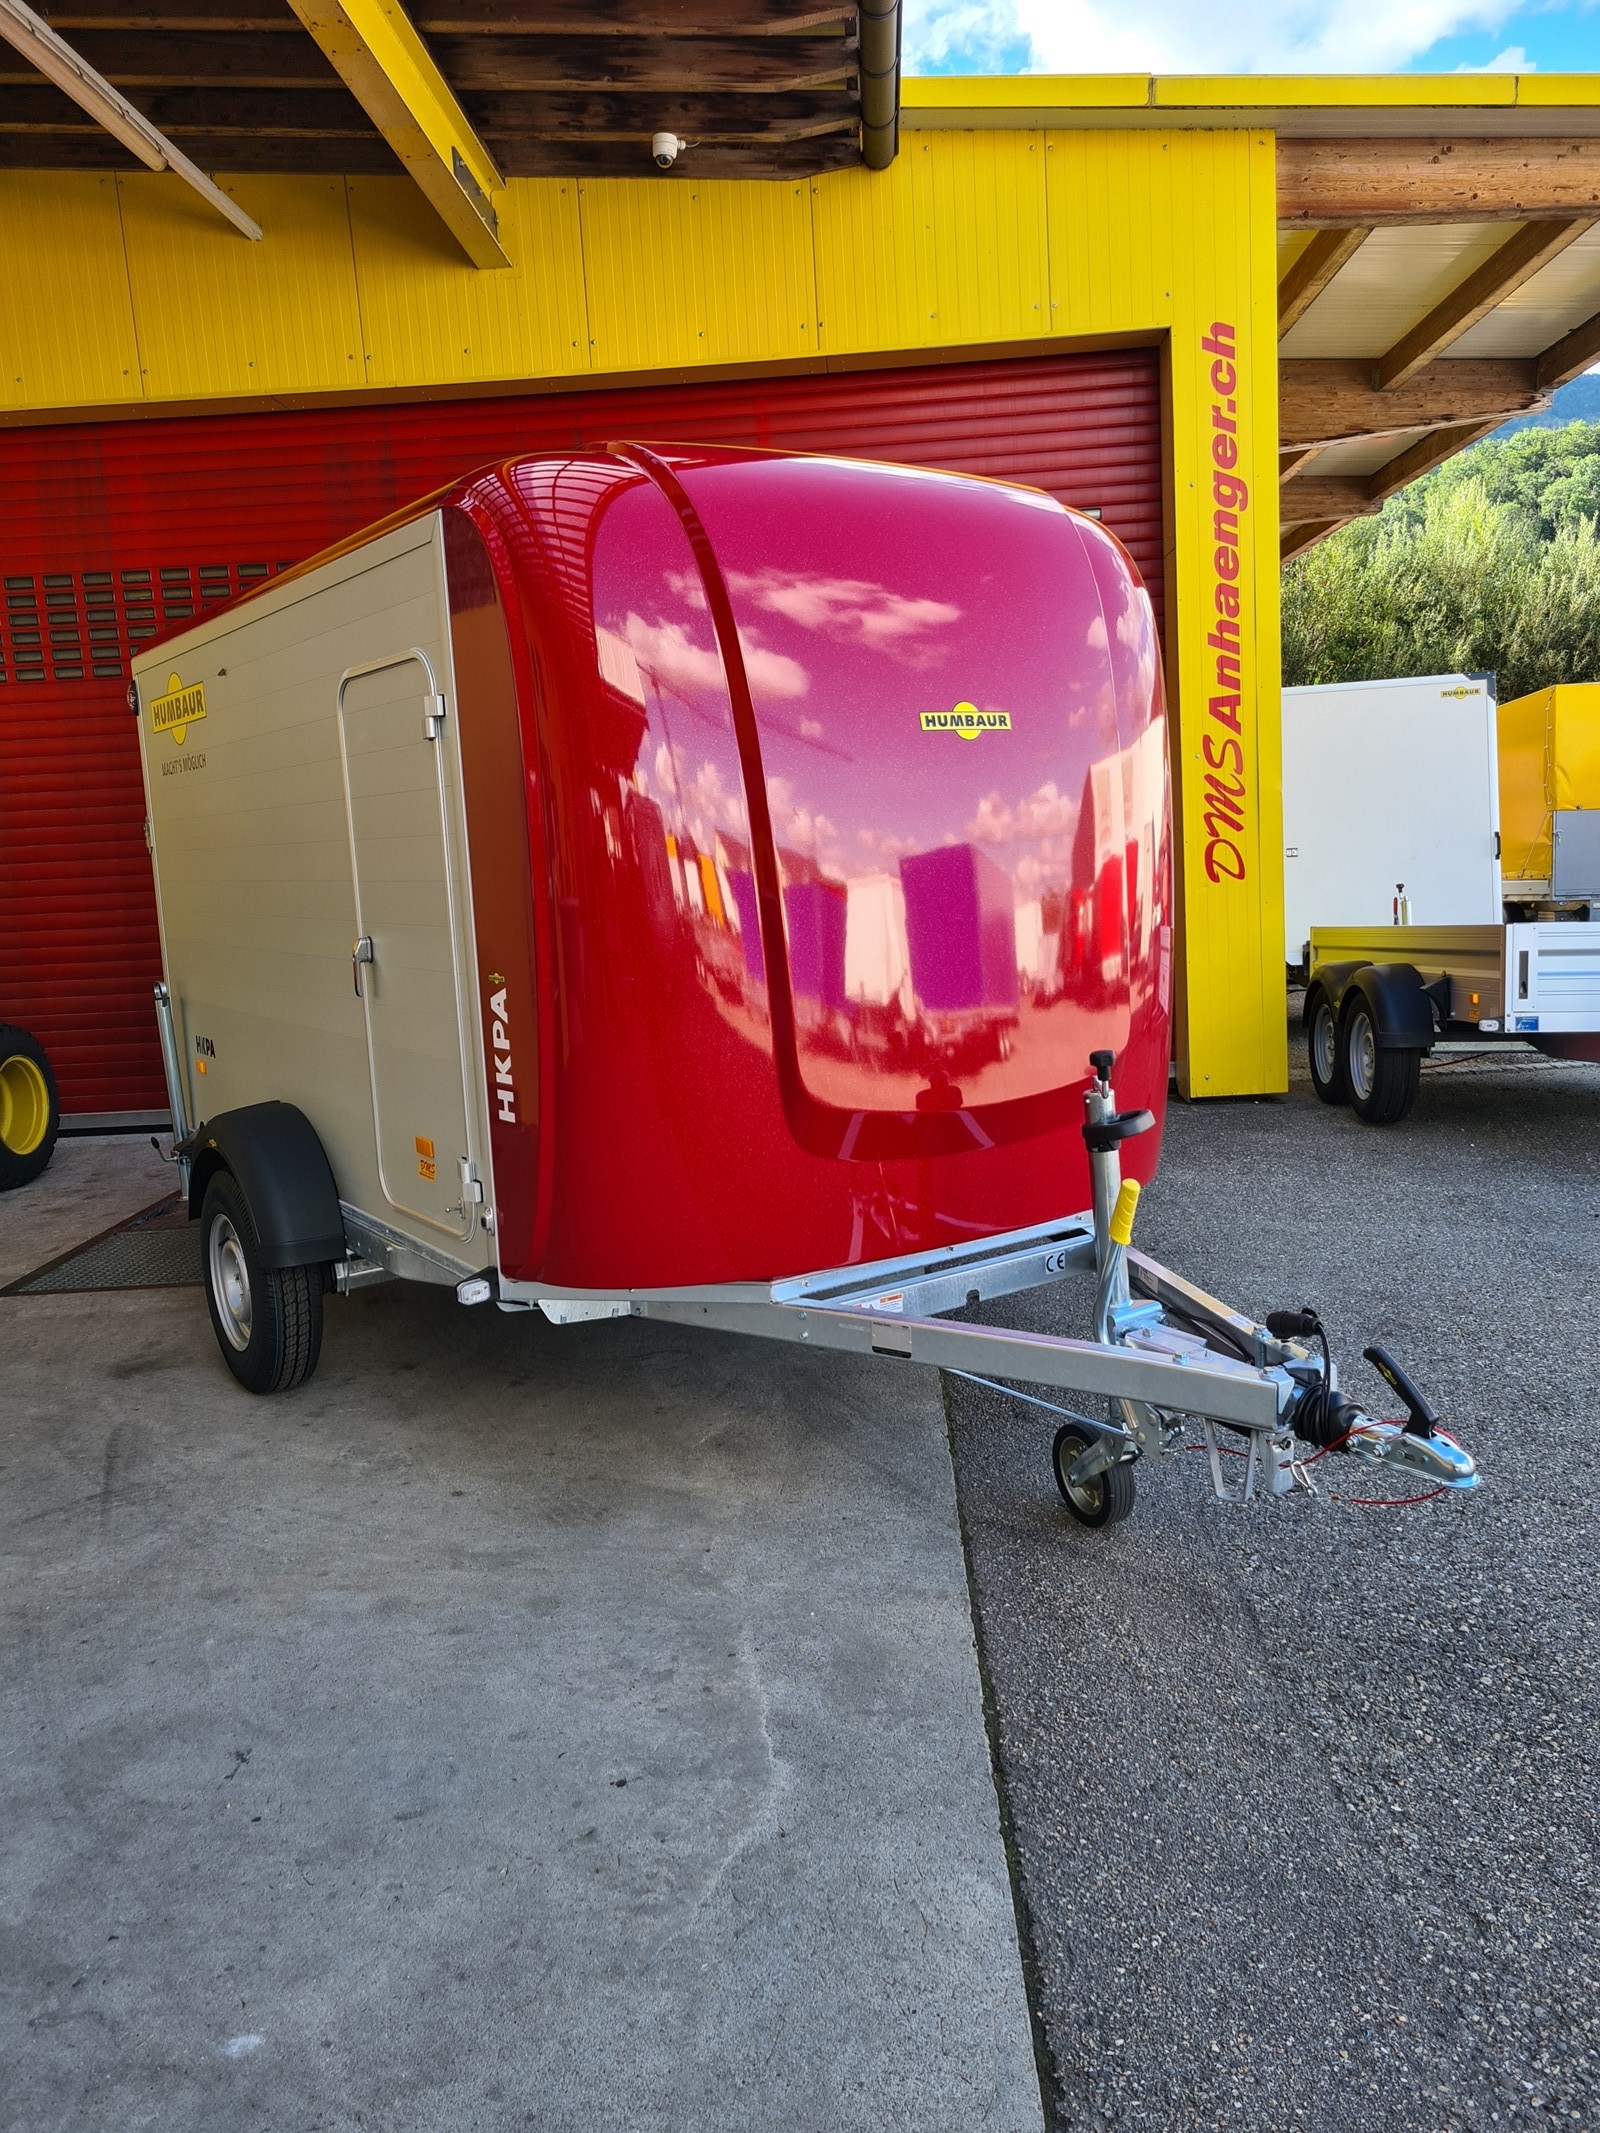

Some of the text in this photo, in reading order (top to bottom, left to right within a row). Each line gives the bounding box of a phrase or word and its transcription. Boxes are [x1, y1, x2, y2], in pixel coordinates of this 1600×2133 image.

[153, 689, 204, 727] HUMBAUR
[924, 715, 1008, 727] HUMBAUR
[182, 753, 207, 771] MÖGLICH
[195, 1035, 216, 1058] HKPA
[490, 988, 516, 1123] HKPA
[1046, 1253, 1065, 1272] CE
